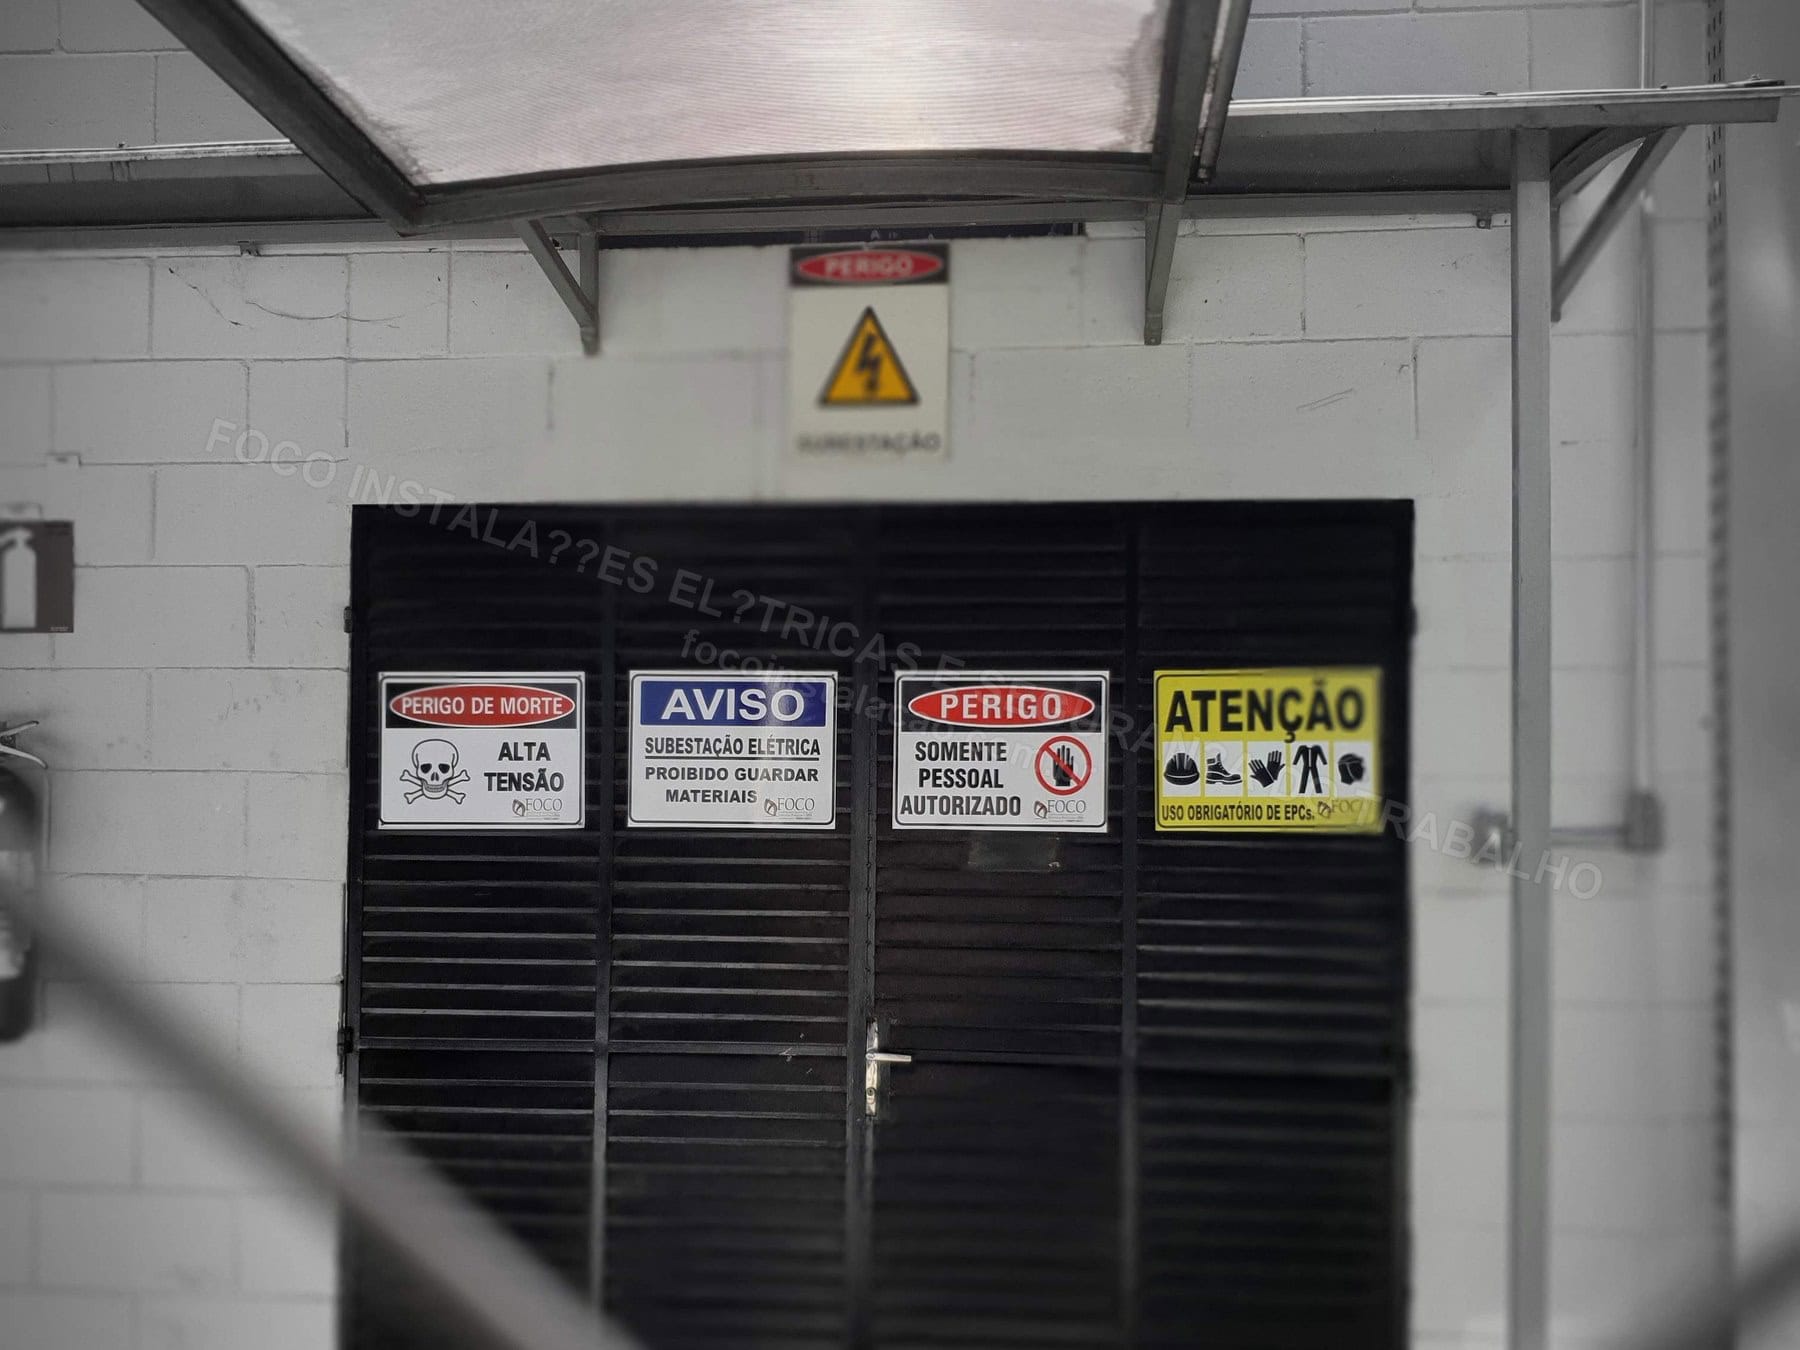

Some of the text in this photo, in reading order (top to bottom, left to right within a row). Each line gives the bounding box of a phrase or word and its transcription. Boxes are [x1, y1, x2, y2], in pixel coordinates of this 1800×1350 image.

[824, 255, 914, 276] PERIGO
[402, 697, 563, 715] PERIGO DE MORTE
[660, 688, 805, 722] AVISO
[940, 694, 1062, 720] PERIGO
[1164, 678, 1365, 744] ATENÇÃO
[498, 742, 551, 761] ALTA
[645, 734, 821, 758] SUBESTAÇÃO ELÉTRICA
[915, 741, 1007, 762] SOMENTE
[484, 768, 564, 792] TENSÃO
[645, 767, 819, 782] PROIBIDO GUARDAR
[918, 768, 1004, 789] PESSOAL
[525, 798, 563, 812] FOCO
[665, 789, 758, 804] MATERIAIS
[777, 797, 815, 811] FOCO
[900, 795, 1021, 817] AUTORIZADO
[1046, 799, 1087, 814] FOCO
[1331, 799, 1373, 814] FOC
[1161, 805, 1184, 821] USO
[1187, 801, 1264, 821] OBRIGATÓRIO
[1267, 804, 1281, 820] DE
